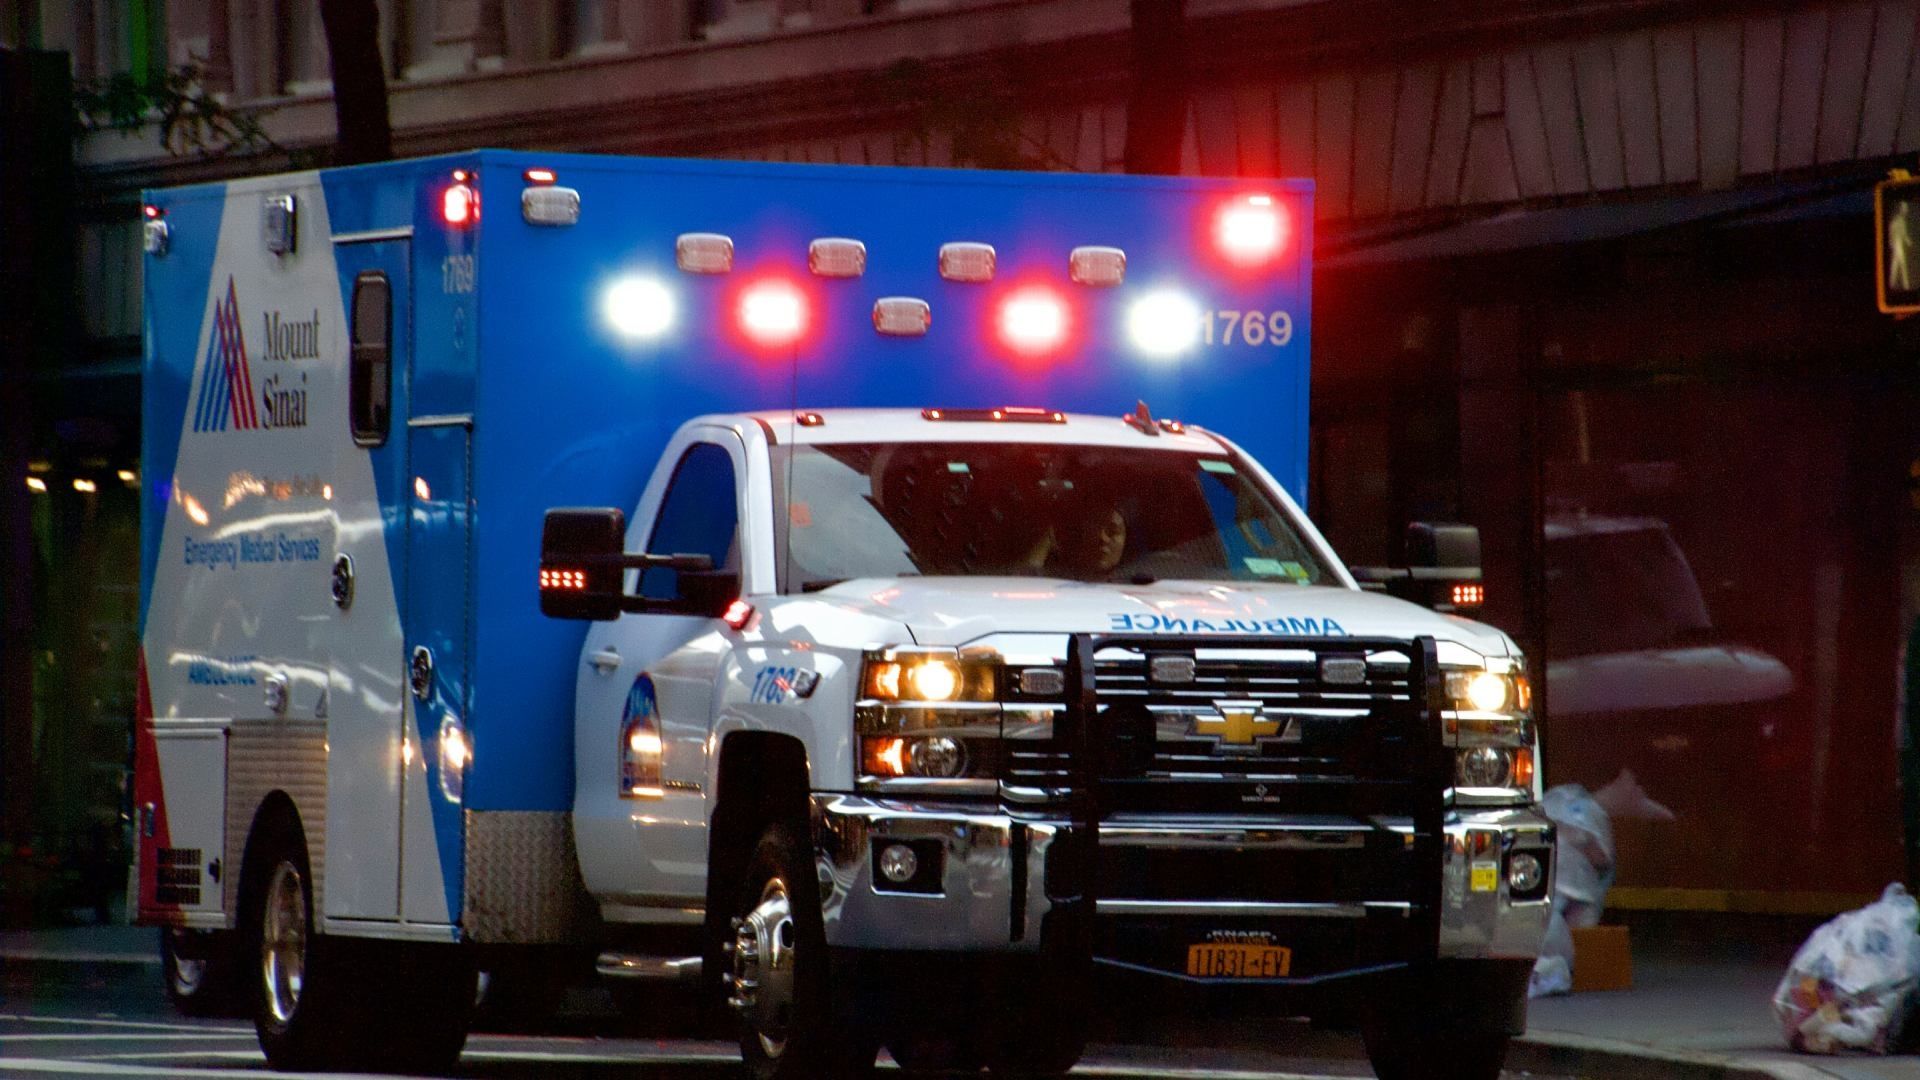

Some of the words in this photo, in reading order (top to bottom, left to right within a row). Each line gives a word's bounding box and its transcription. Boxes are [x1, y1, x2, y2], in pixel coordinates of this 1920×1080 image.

[442, 254, 474, 294] 1769
[263, 307, 321, 362] Mount
[1200, 310, 1293, 346] 1769
[261, 370, 308, 430] Sinai
[184, 534, 237, 571] Emergency
[240, 533, 276, 562] Medical
[277, 532, 320, 562] Services
